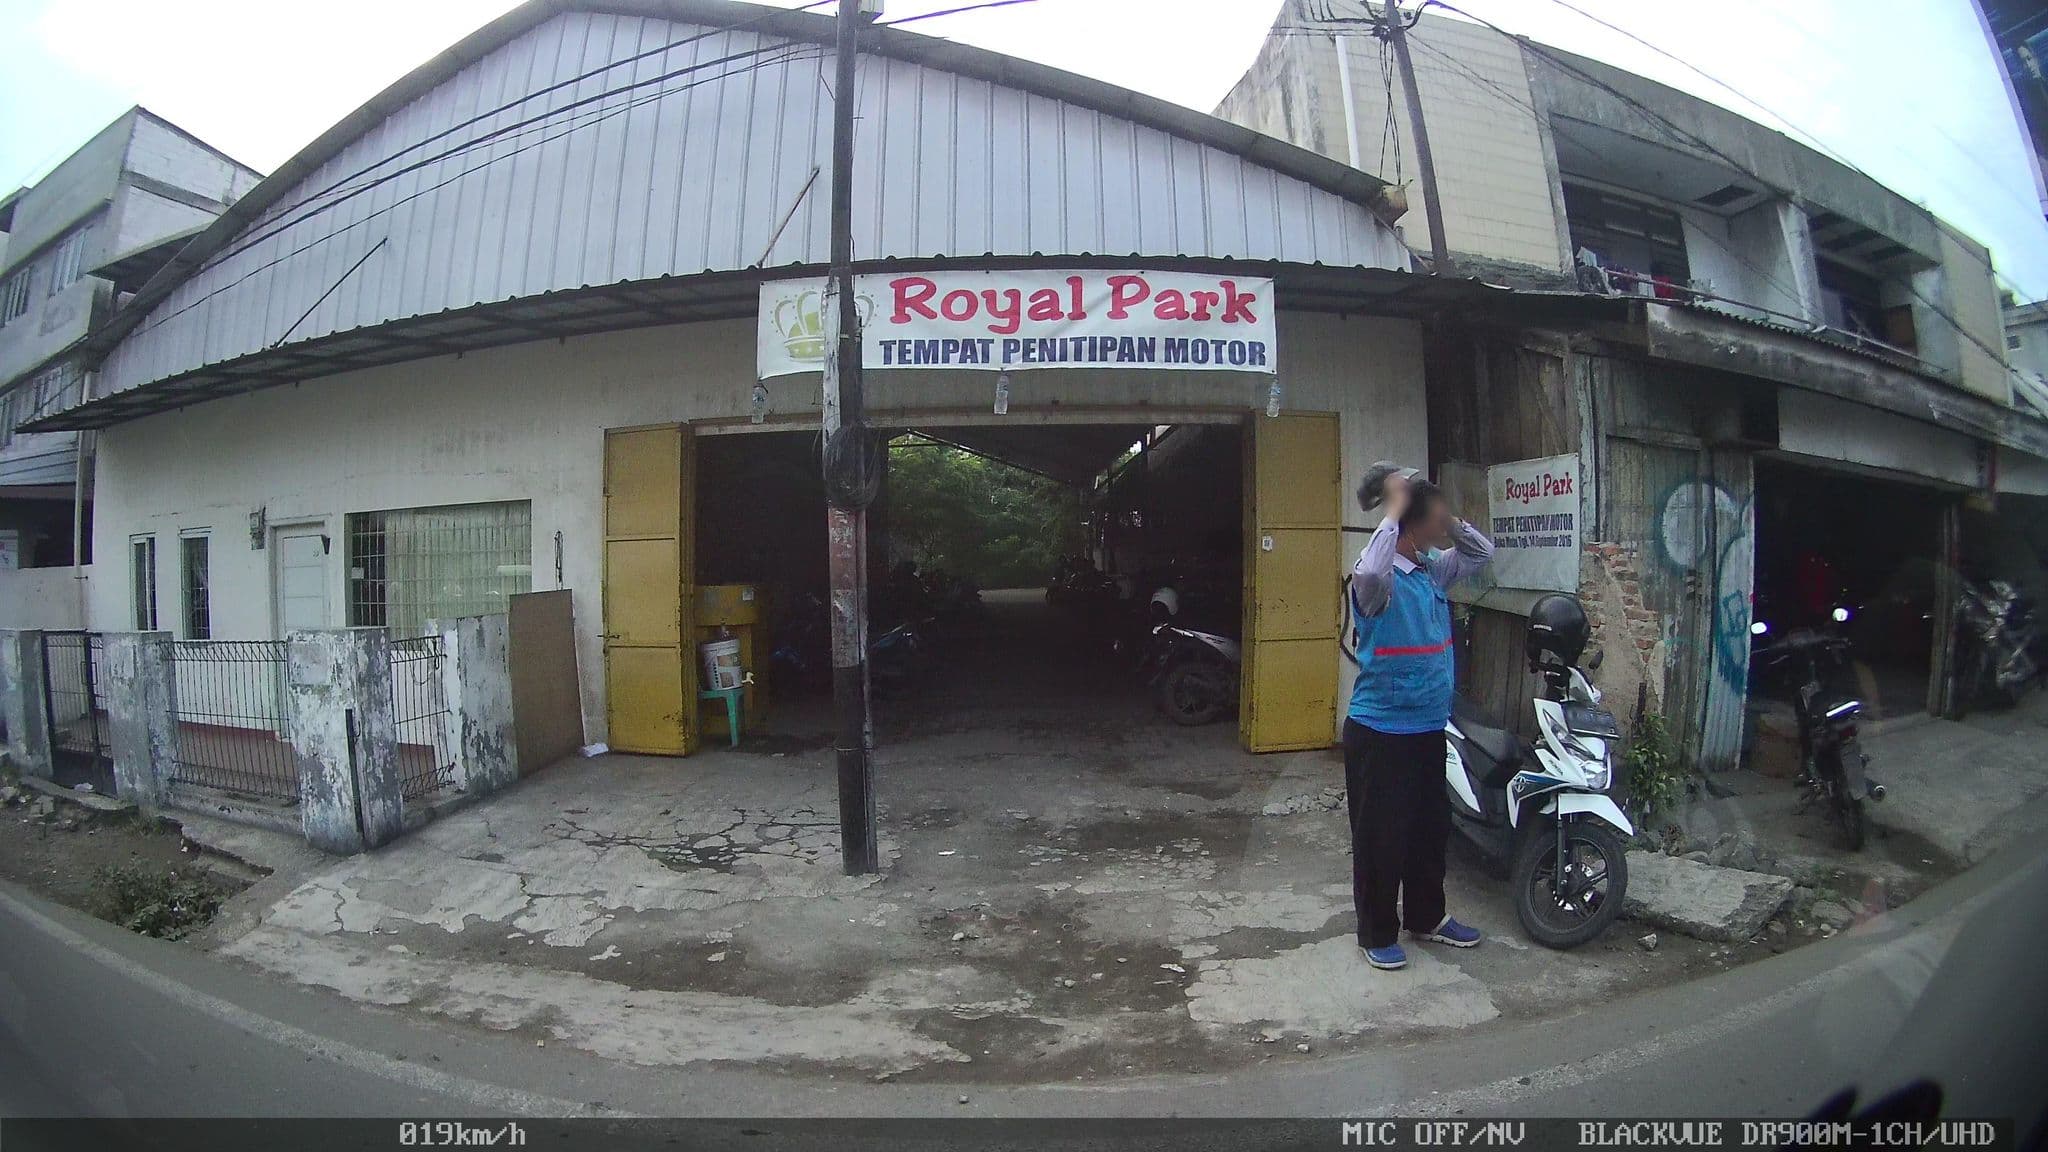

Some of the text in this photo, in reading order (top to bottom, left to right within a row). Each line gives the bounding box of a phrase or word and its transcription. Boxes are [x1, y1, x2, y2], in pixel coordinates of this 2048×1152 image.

[889, 275, 1257, 335] Royal Park
[879, 336, 1266, 366] TEMPAT PENITIPAN MOTOR
[1505, 471, 1573, 504] Royal Park
